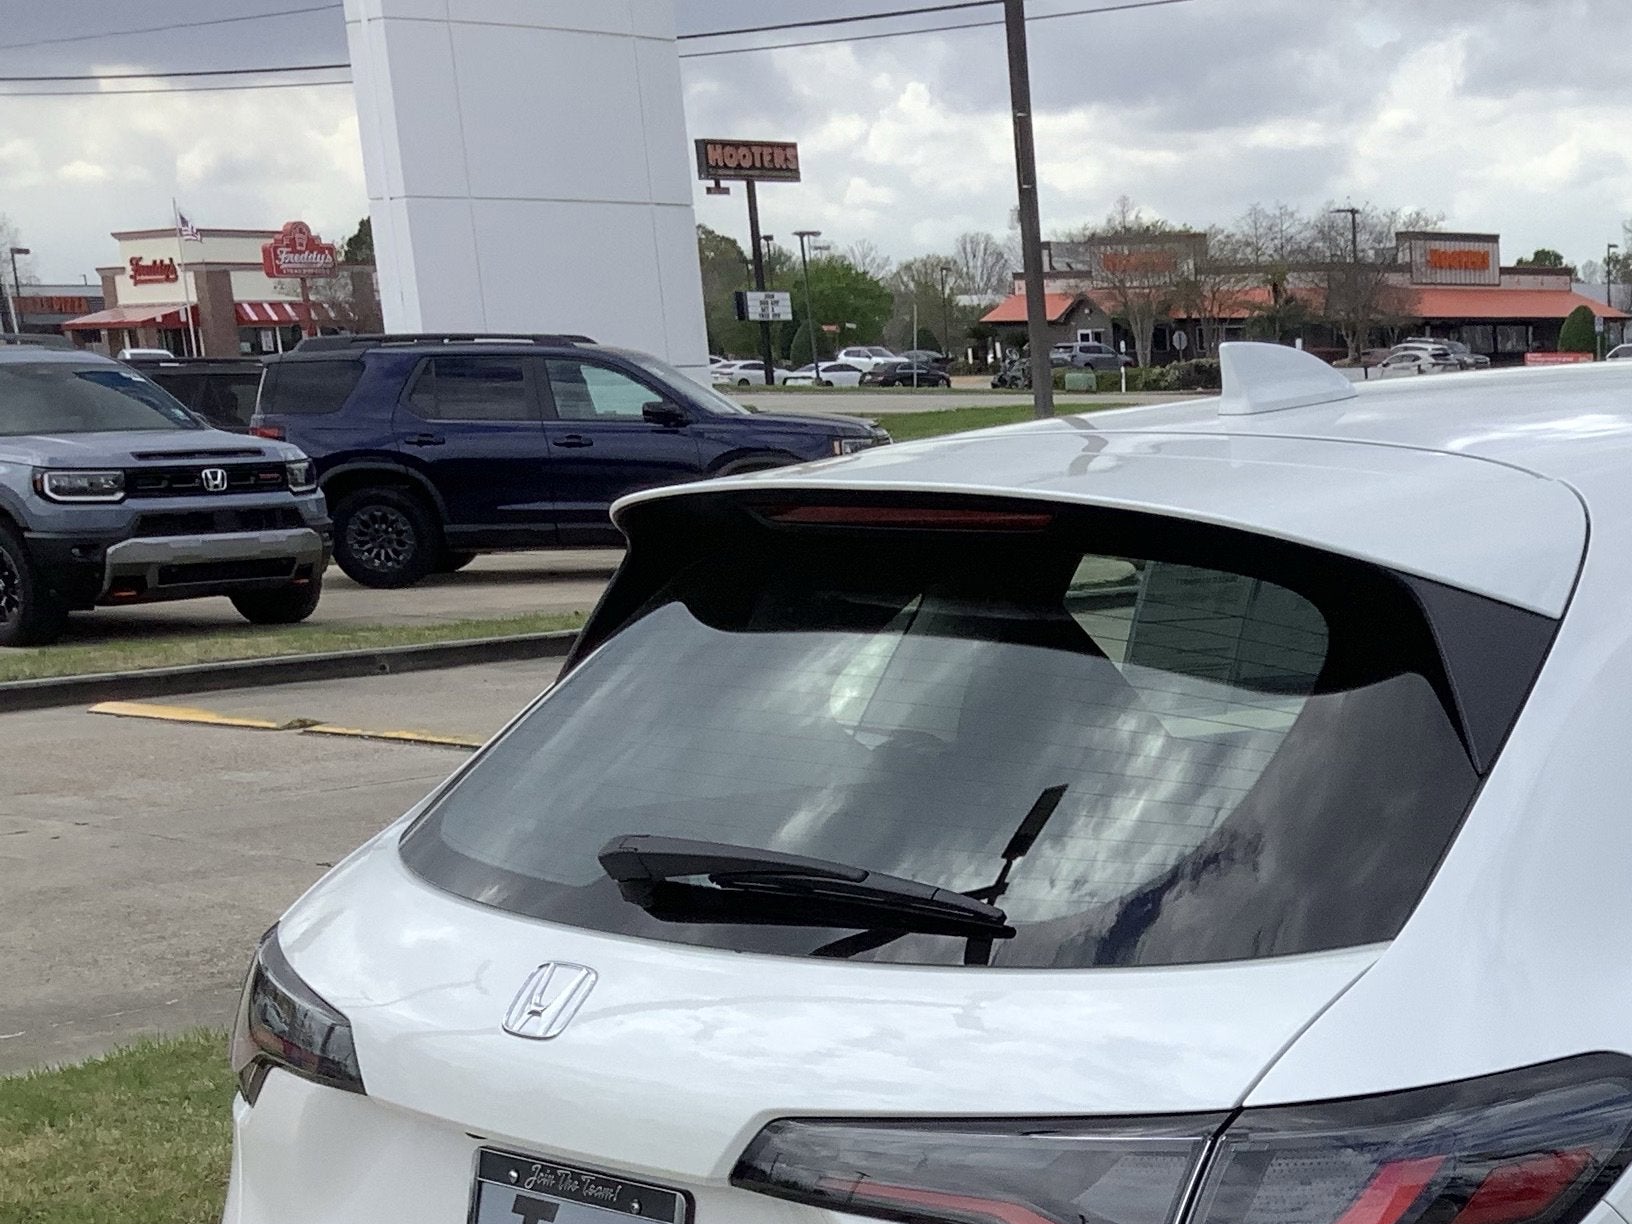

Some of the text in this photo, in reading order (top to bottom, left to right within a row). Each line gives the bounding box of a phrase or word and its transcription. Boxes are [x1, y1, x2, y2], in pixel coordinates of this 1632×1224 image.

[706, 143, 798, 170] HOOTERS
[275, 247, 333, 268] Freddy's
[524, 1164, 556, 1190] Join
[557, 1169, 580, 1192] The
